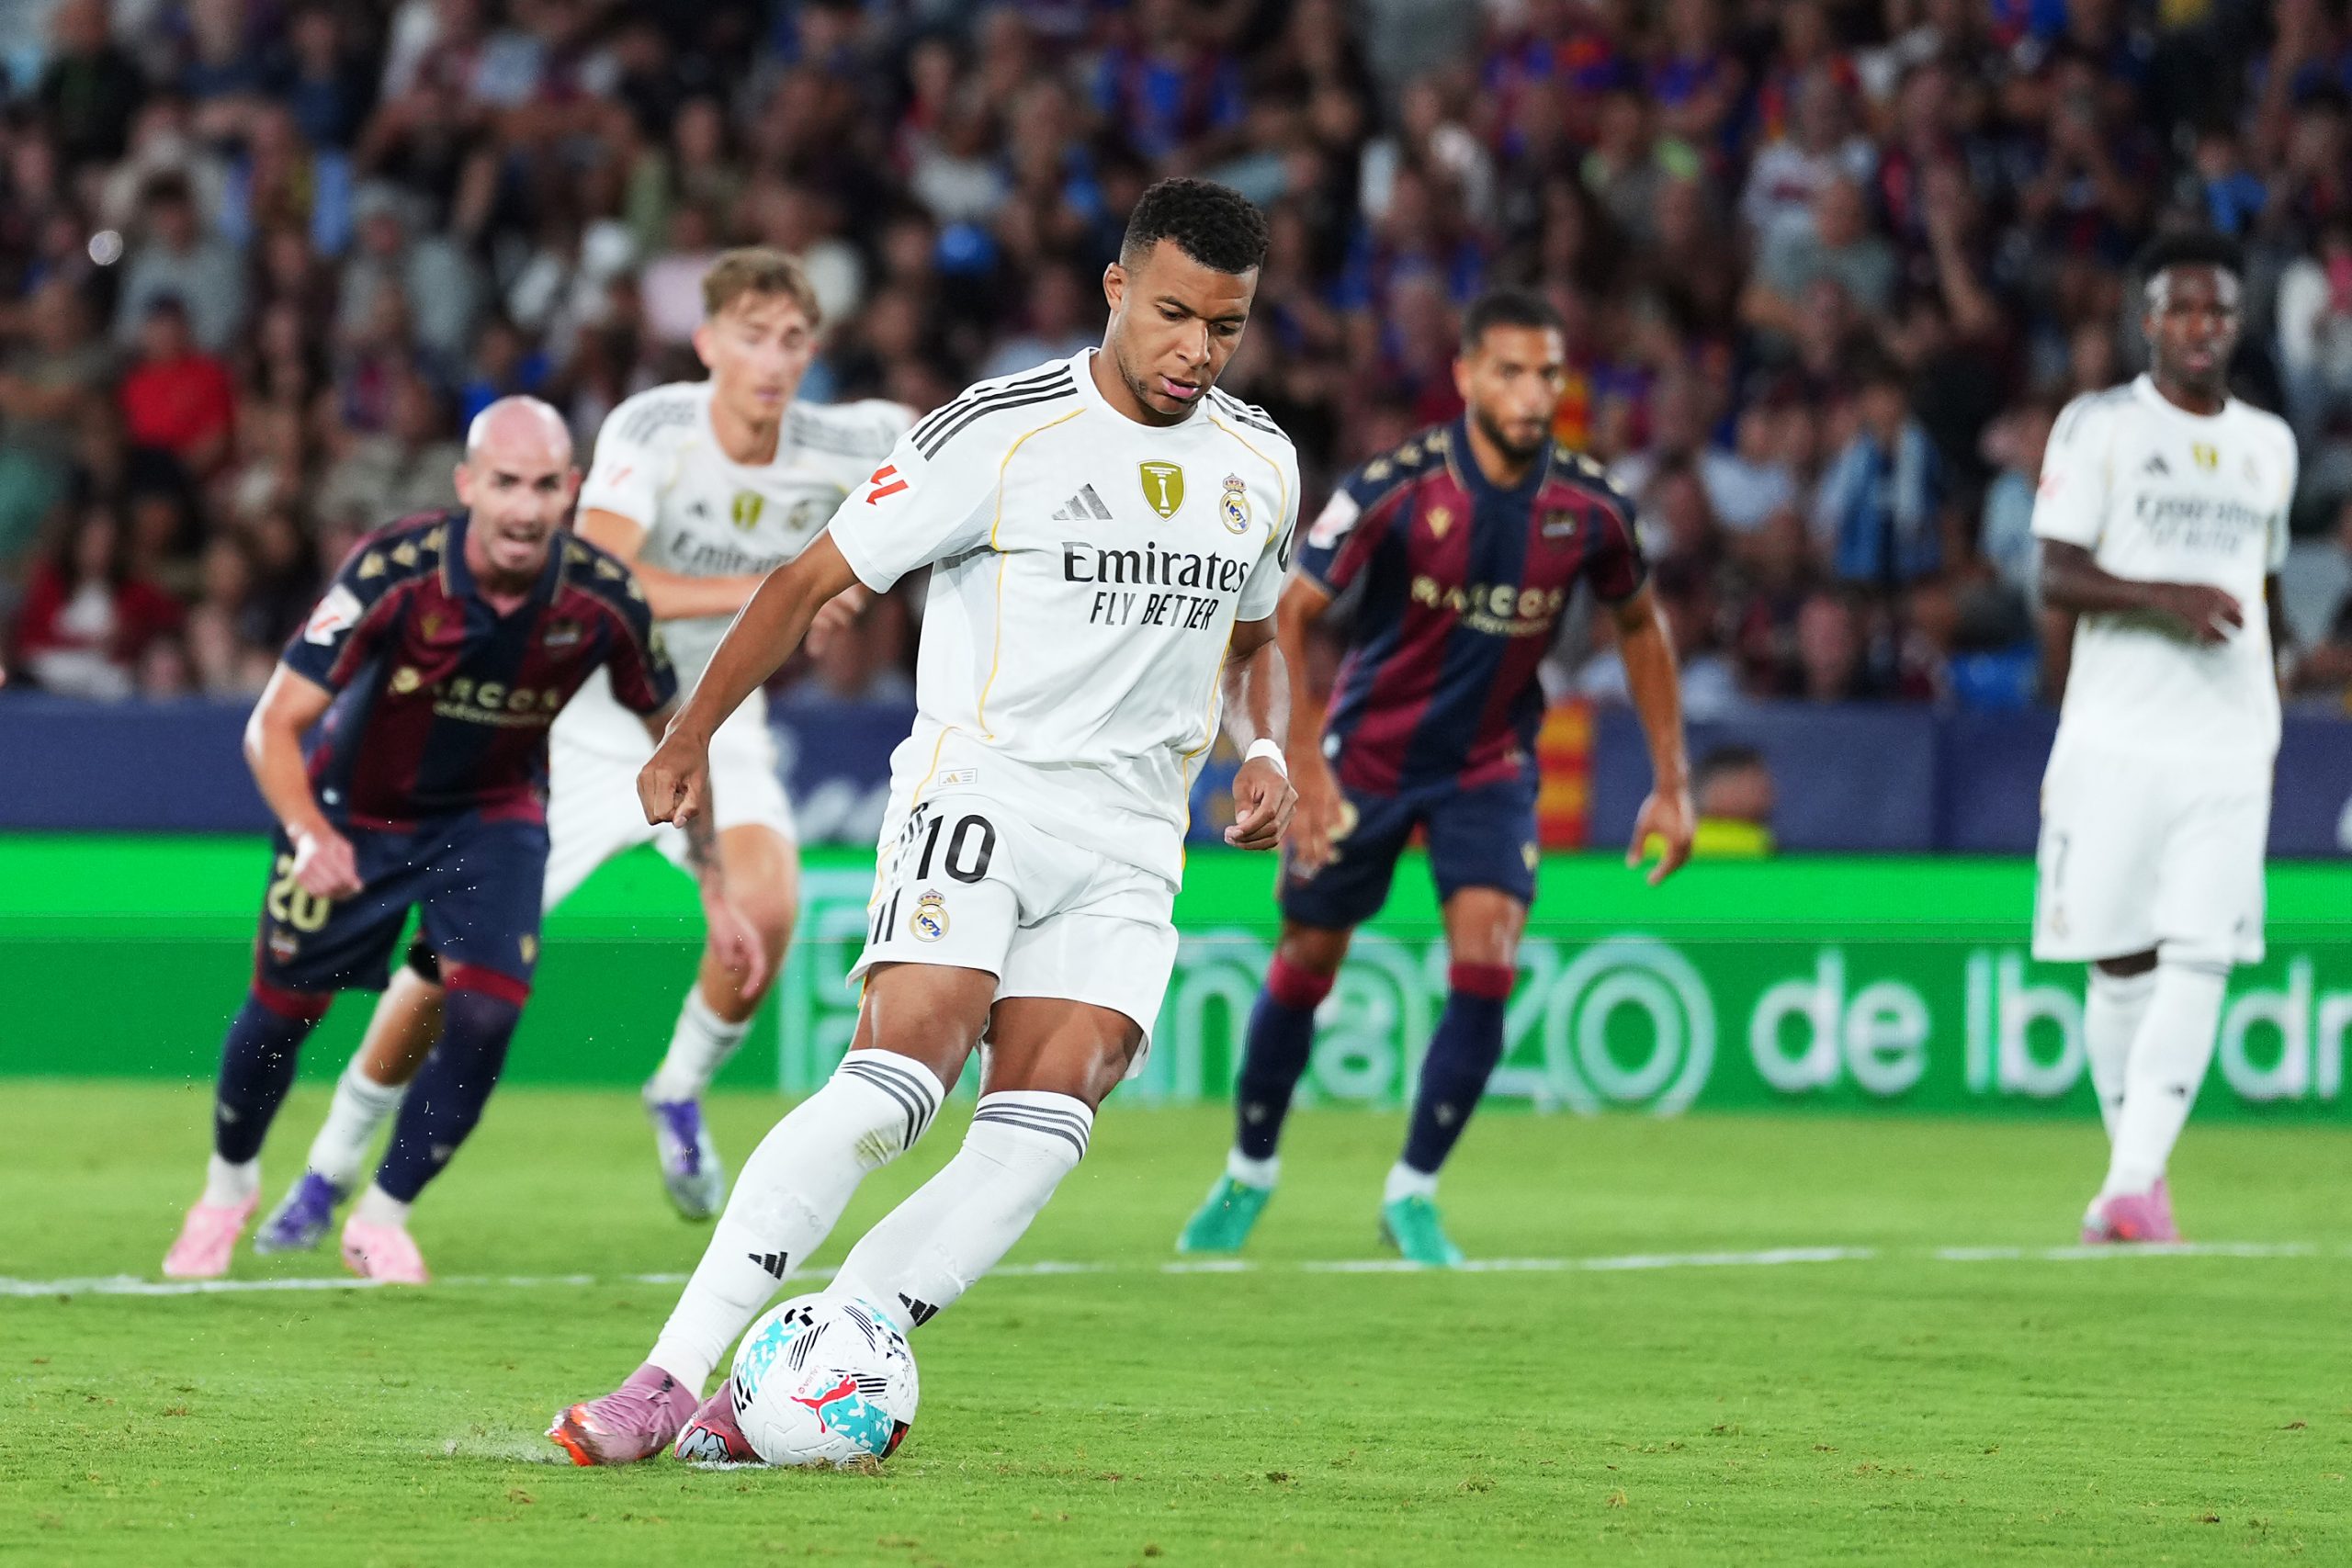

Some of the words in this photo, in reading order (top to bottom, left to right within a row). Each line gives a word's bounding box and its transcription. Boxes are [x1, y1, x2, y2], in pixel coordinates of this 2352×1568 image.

[1062, 541, 1249, 592] Emirates
[1090, 592, 1136, 626] FLY
[1141, 593, 1219, 630] BETTER
[916, 814, 996, 884] 10
[1750, 946, 1929, 1095] de
